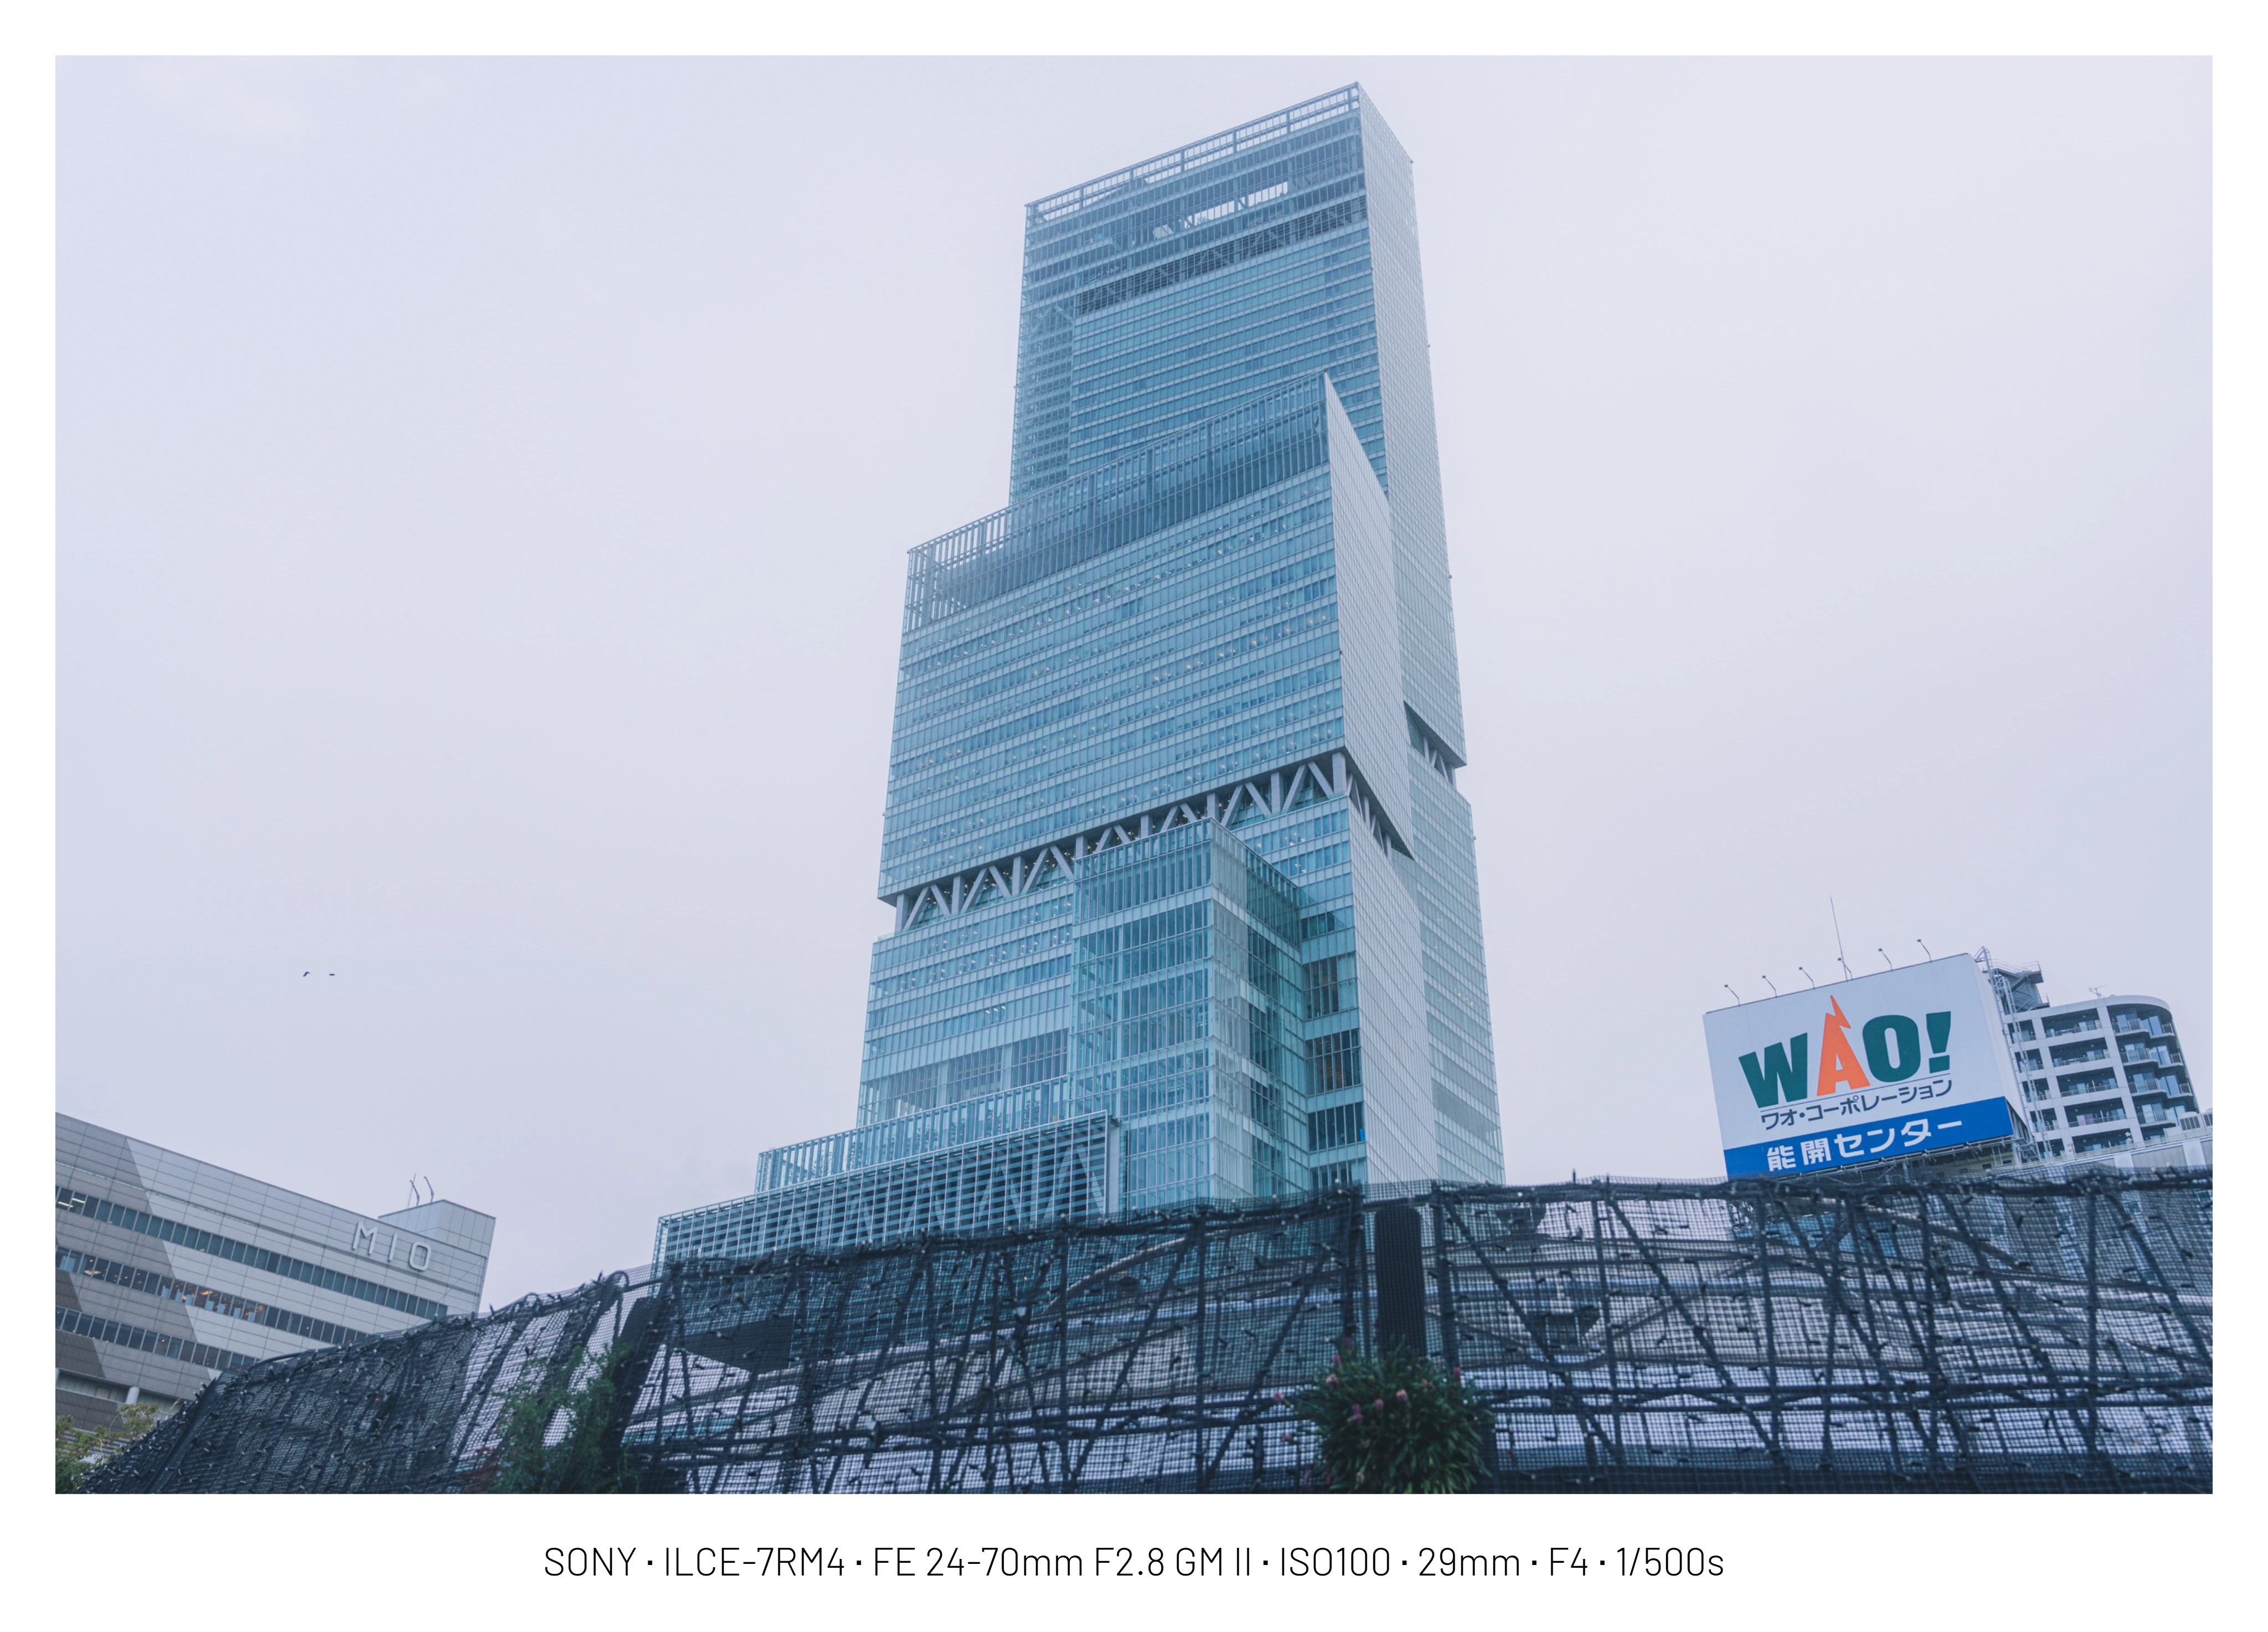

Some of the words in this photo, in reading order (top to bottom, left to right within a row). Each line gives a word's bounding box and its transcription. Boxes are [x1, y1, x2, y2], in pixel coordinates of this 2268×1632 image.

[1738, 995, 1951, 1108] WAO!
[1761, 1079, 1952, 1130] ワオ・コーポレーション
[1766, 1118, 1962, 1172] 能開センター
[352, 1221, 431, 1272] MIO
